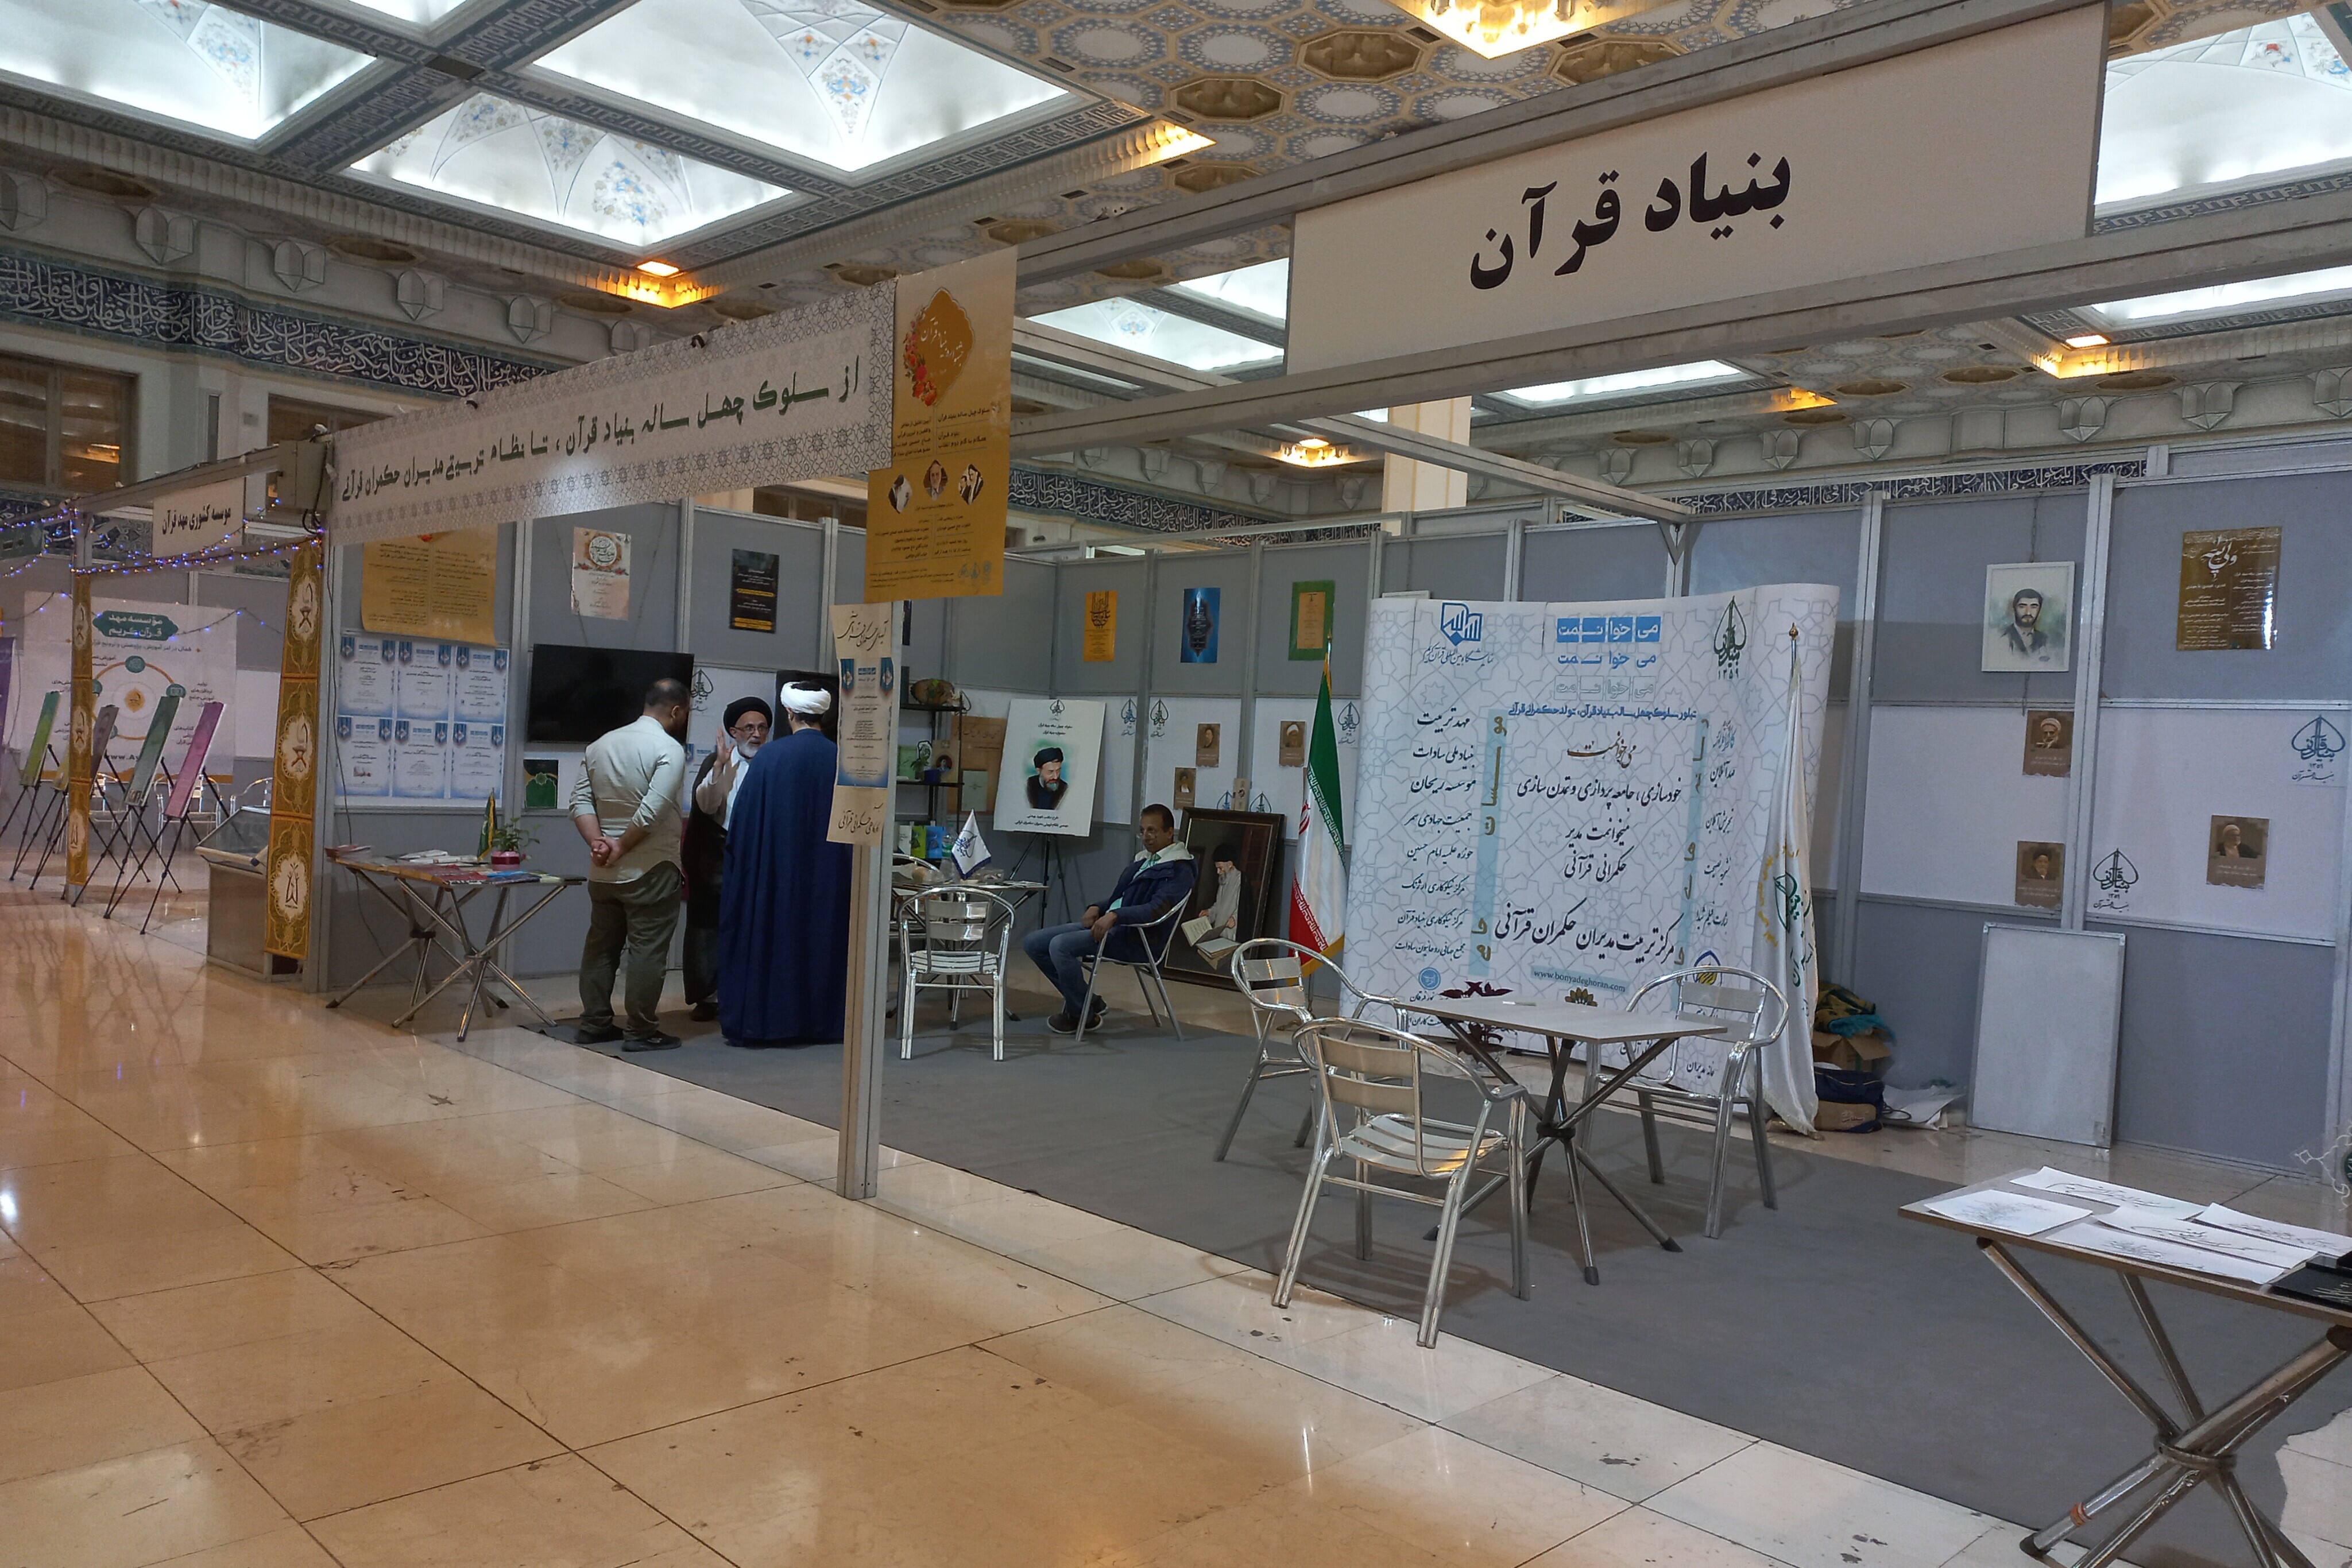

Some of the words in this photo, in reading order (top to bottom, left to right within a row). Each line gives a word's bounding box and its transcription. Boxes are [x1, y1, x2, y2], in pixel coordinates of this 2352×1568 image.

[1645, 150, 1792, 241] بنیاد
[1468, 170, 1620, 291] قرآن
[839, 354, 859, 402] از
[753, 372, 829, 416] سلوک
[641, 402, 689, 433] ساله
[697, 393, 745, 425] چهل
[603, 412, 635, 447] بنیاد
[490, 433, 525, 461] نظام
[531, 431, 548, 456] تا
[404, 456, 443, 488] مدیران
[446, 450, 483, 481] تربیتی
[342, 469, 363, 501] قرآنی
[365, 465, 400, 495] حکمران
[162, 509, 176, 535] قرآن
[109, 614, 126, 622] مهد
[127, 616, 163, 626] مؤسسه
[1417, 707, 1457, 733] تربیت
[1453, 718, 1470, 728] عهد
[1678, 707, 1697, 720] تبلور
[1413, 746, 1445, 758] سادات
[1445, 745, 1459, 764] ملی
[1410, 775, 1445, 795] ریحان
[1517, 775, 1546, 797] سازی
[1546, 775, 1571, 799] تمدن
[1569, 784, 1576, 795] و
[1577, 779, 1614, 810] پردازی
[1565, 828, 1583, 849] مدیر
[1406, 843, 1428, 861] حسین
[1427, 846, 1442, 866] امام
[1457, 847, 1473, 859] حوزه
[1564, 850, 1595, 880] قرآنی
[1595, 845, 1635, 882] حکمرانی
[1428, 874, 1459, 895] نیکوکاری
[1454, 876, 1470, 896] مرکز
[1397, 910, 1416, 924] قرآن
[1426, 908, 1457, 928] نیکوکاری
[1451, 909, 1468, 929] مرکز
[1494, 902, 1535, 941] قرآنی
[1531, 897, 1588, 946] حکمران
[1576, 928, 1615, 960] مدیران
[1616, 927, 1659, 963] تربیت
[1655, 912, 1684, 964] مرکز
[1534, 970, 1626, 993] www.bonyadeghoran.com
